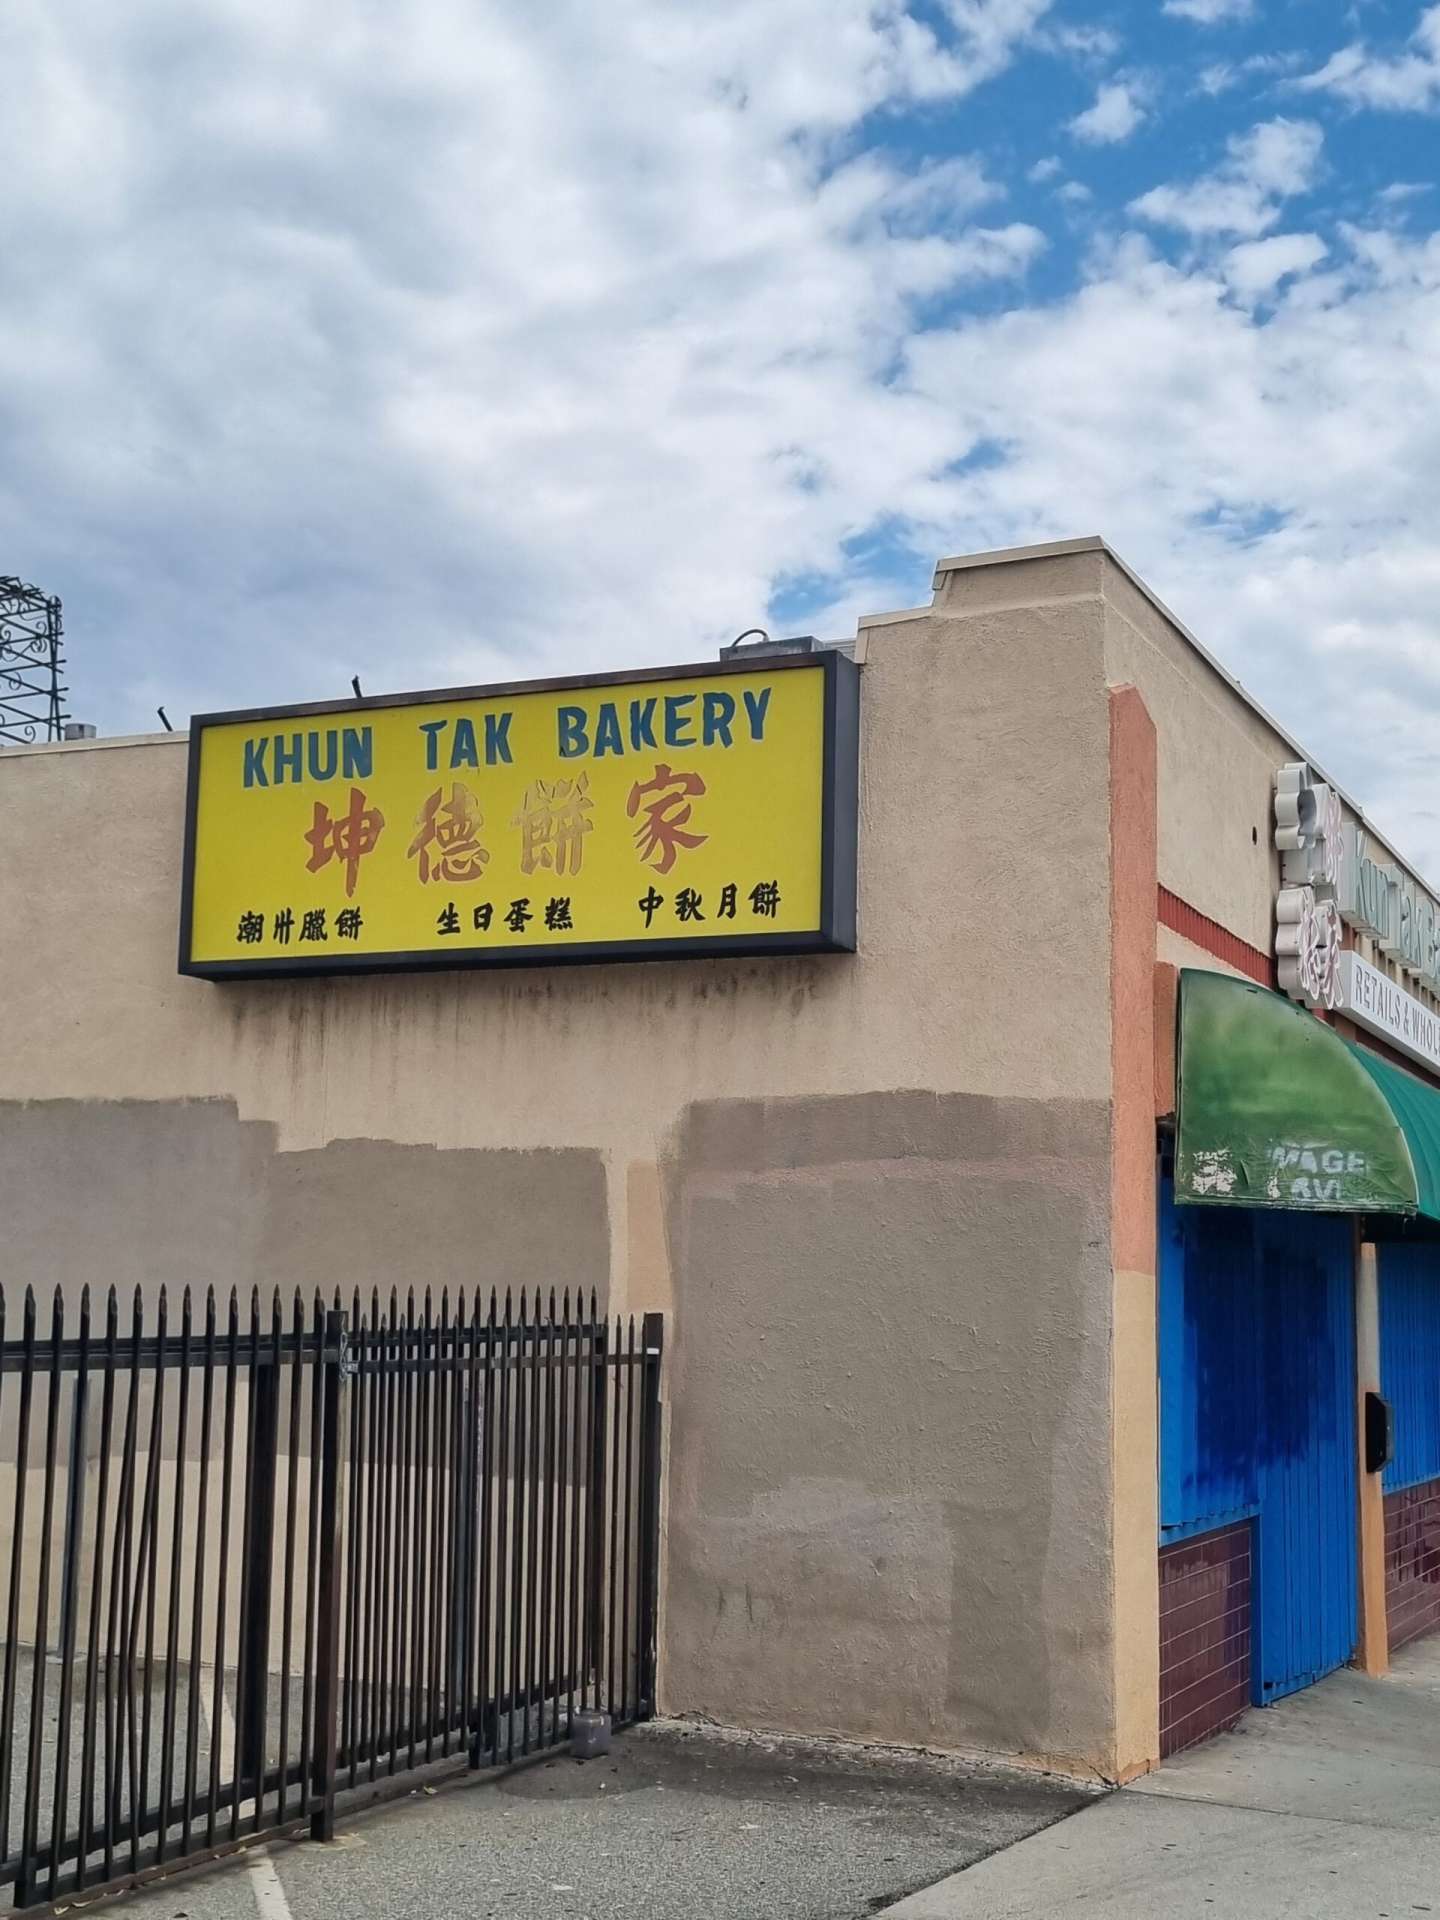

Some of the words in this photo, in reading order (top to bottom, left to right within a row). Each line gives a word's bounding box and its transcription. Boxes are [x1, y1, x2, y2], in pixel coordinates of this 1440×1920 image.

[243, 726, 374, 788] KHUN
[418, 712, 514, 771] TAK
[557, 687, 773, 758] BAKERY
[305, 763, 710, 898] 坤德餅家
[436, 896, 574, 936] 生日蛋糕
[637, 879, 782, 929] 中秋月餅
[1355, 964, 1401, 1030] RETAILS
[1403, 1001, 1410, 1036] &
